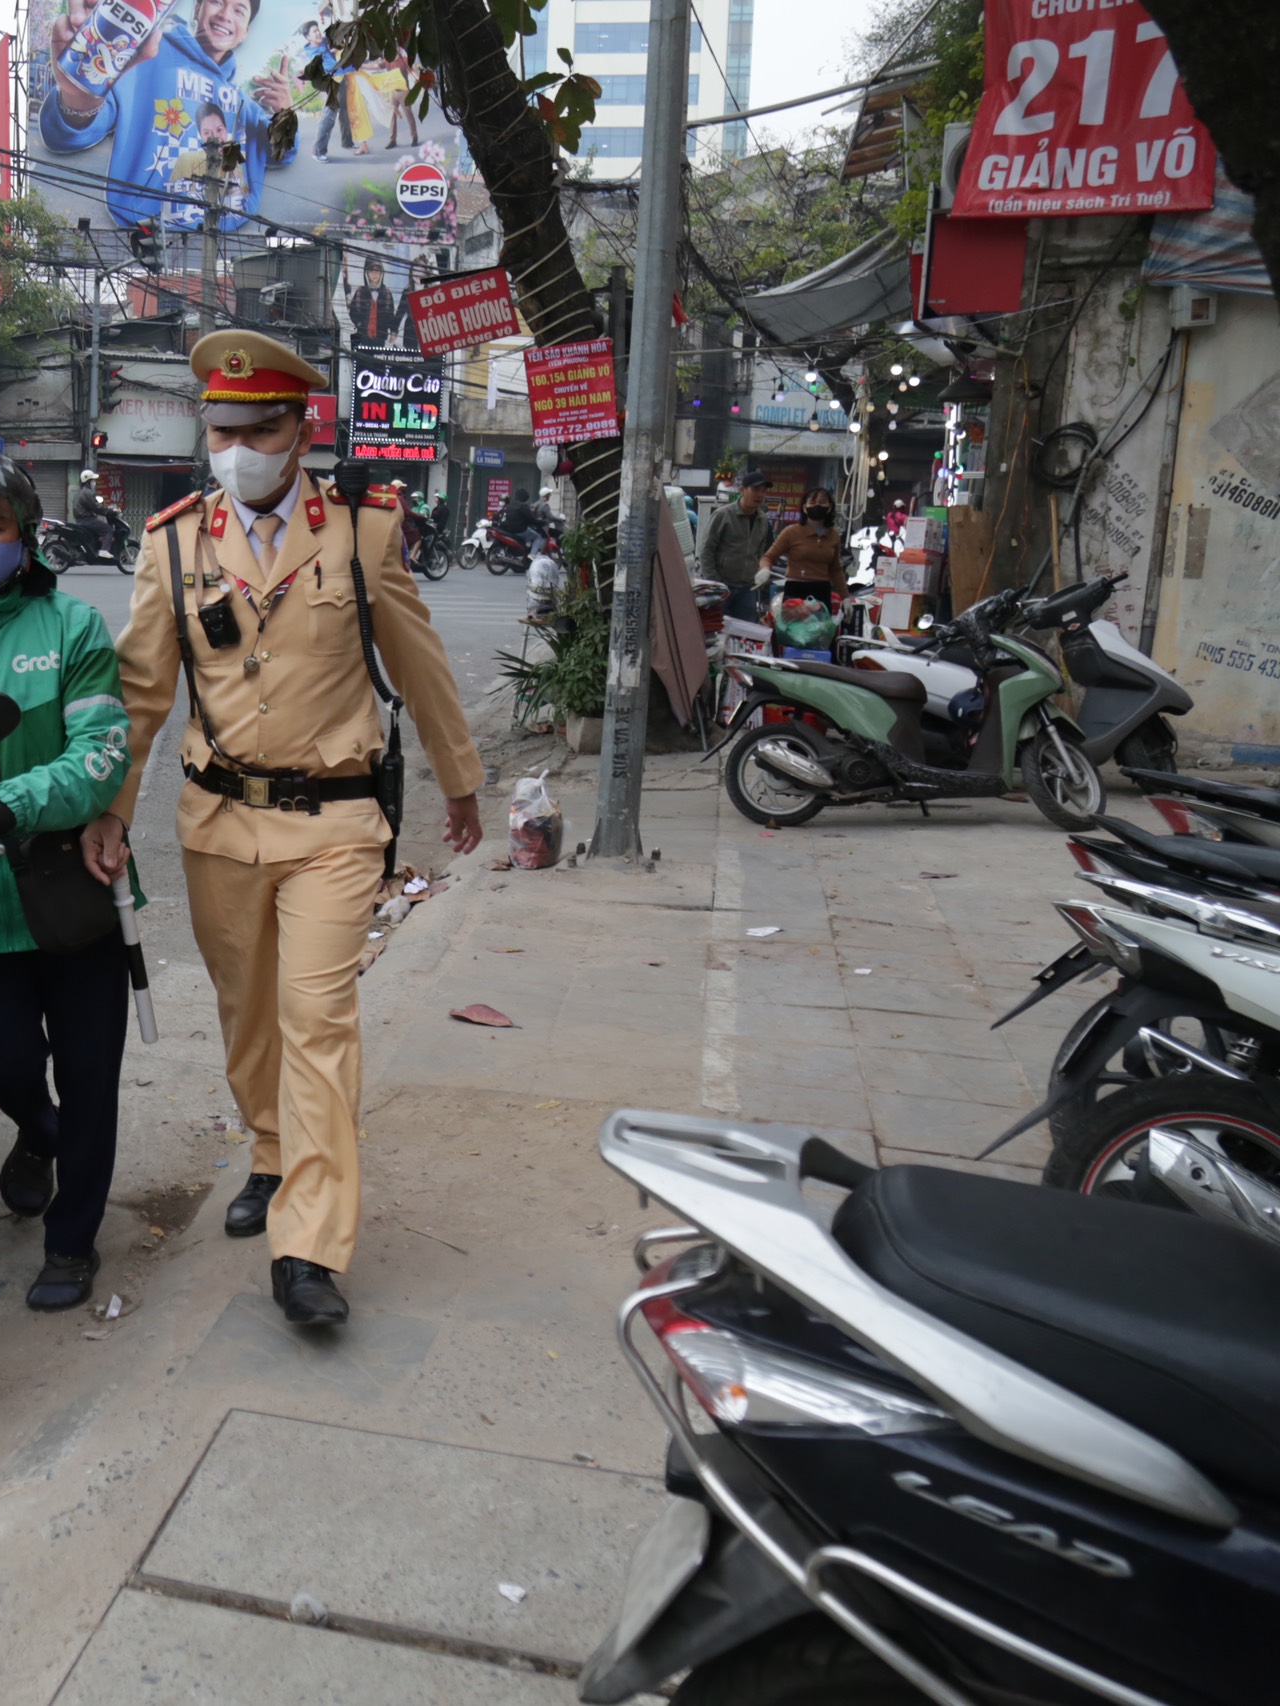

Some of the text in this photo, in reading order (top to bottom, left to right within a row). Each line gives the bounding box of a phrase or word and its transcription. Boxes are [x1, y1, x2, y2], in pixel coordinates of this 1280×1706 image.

[102, 0, 148, 38] PEPSI
[177, 69, 214, 102] MẸ
[993, 20, 1179, 136] 217
[977, 126, 1196, 191] GIẢNG VÕ
[400, 184, 444, 197] PEPSI
[988, 191, 1170, 214] (gần hiệu sách Trí Tuệ)
[450, 277, 497, 300] ĐIỆN
[418, 297, 513, 344] HỒNG HƯƠNG
[428, 343, 451, 354] 160
[453, 332, 493, 349] GIẢNG
[356, 367, 440, 400] Quảng Cáo
[567, 365, 596, 380] GIẢNG
[148, 399, 196, 423] KEBAB
[555, 397, 567, 409] 39
[569, 393, 587, 408] HÀO
[589, 391, 612, 404] NAM
[392, 402, 438, 430] LED
[12, 650, 61, 674] Grab
[1226, 649, 1256, 672] 555
[891, 1470, 1133, 1578] LEAD
